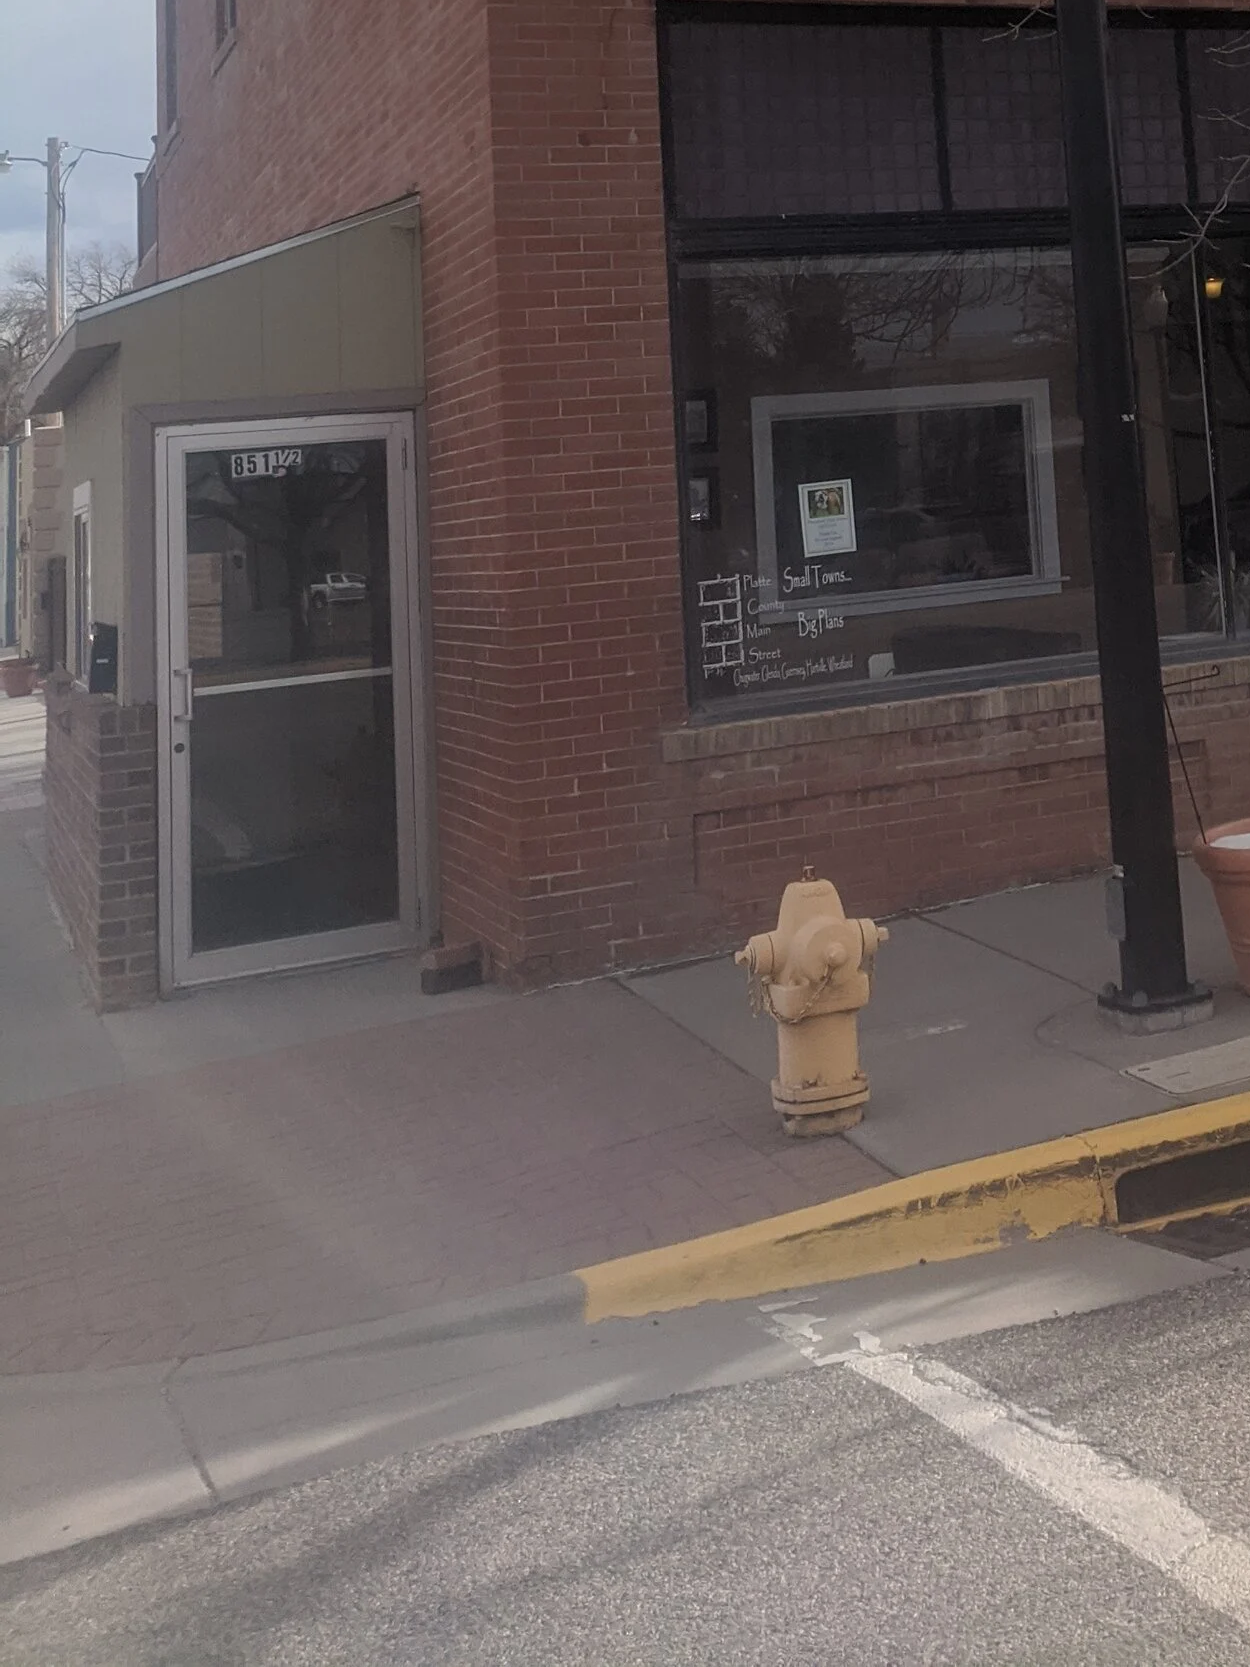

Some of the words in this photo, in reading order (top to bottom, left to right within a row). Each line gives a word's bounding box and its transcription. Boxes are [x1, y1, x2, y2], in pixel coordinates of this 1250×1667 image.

[234, 453, 270, 476] 851
[743, 574, 773, 592] Platte
[782, 565, 811, 593] Small
[747, 598, 786, 615] County
[746, 623, 772, 640] Main
[797, 612, 818, 639] Big
[818, 608, 845, 634] Plans
[748, 647, 782, 665] Street
